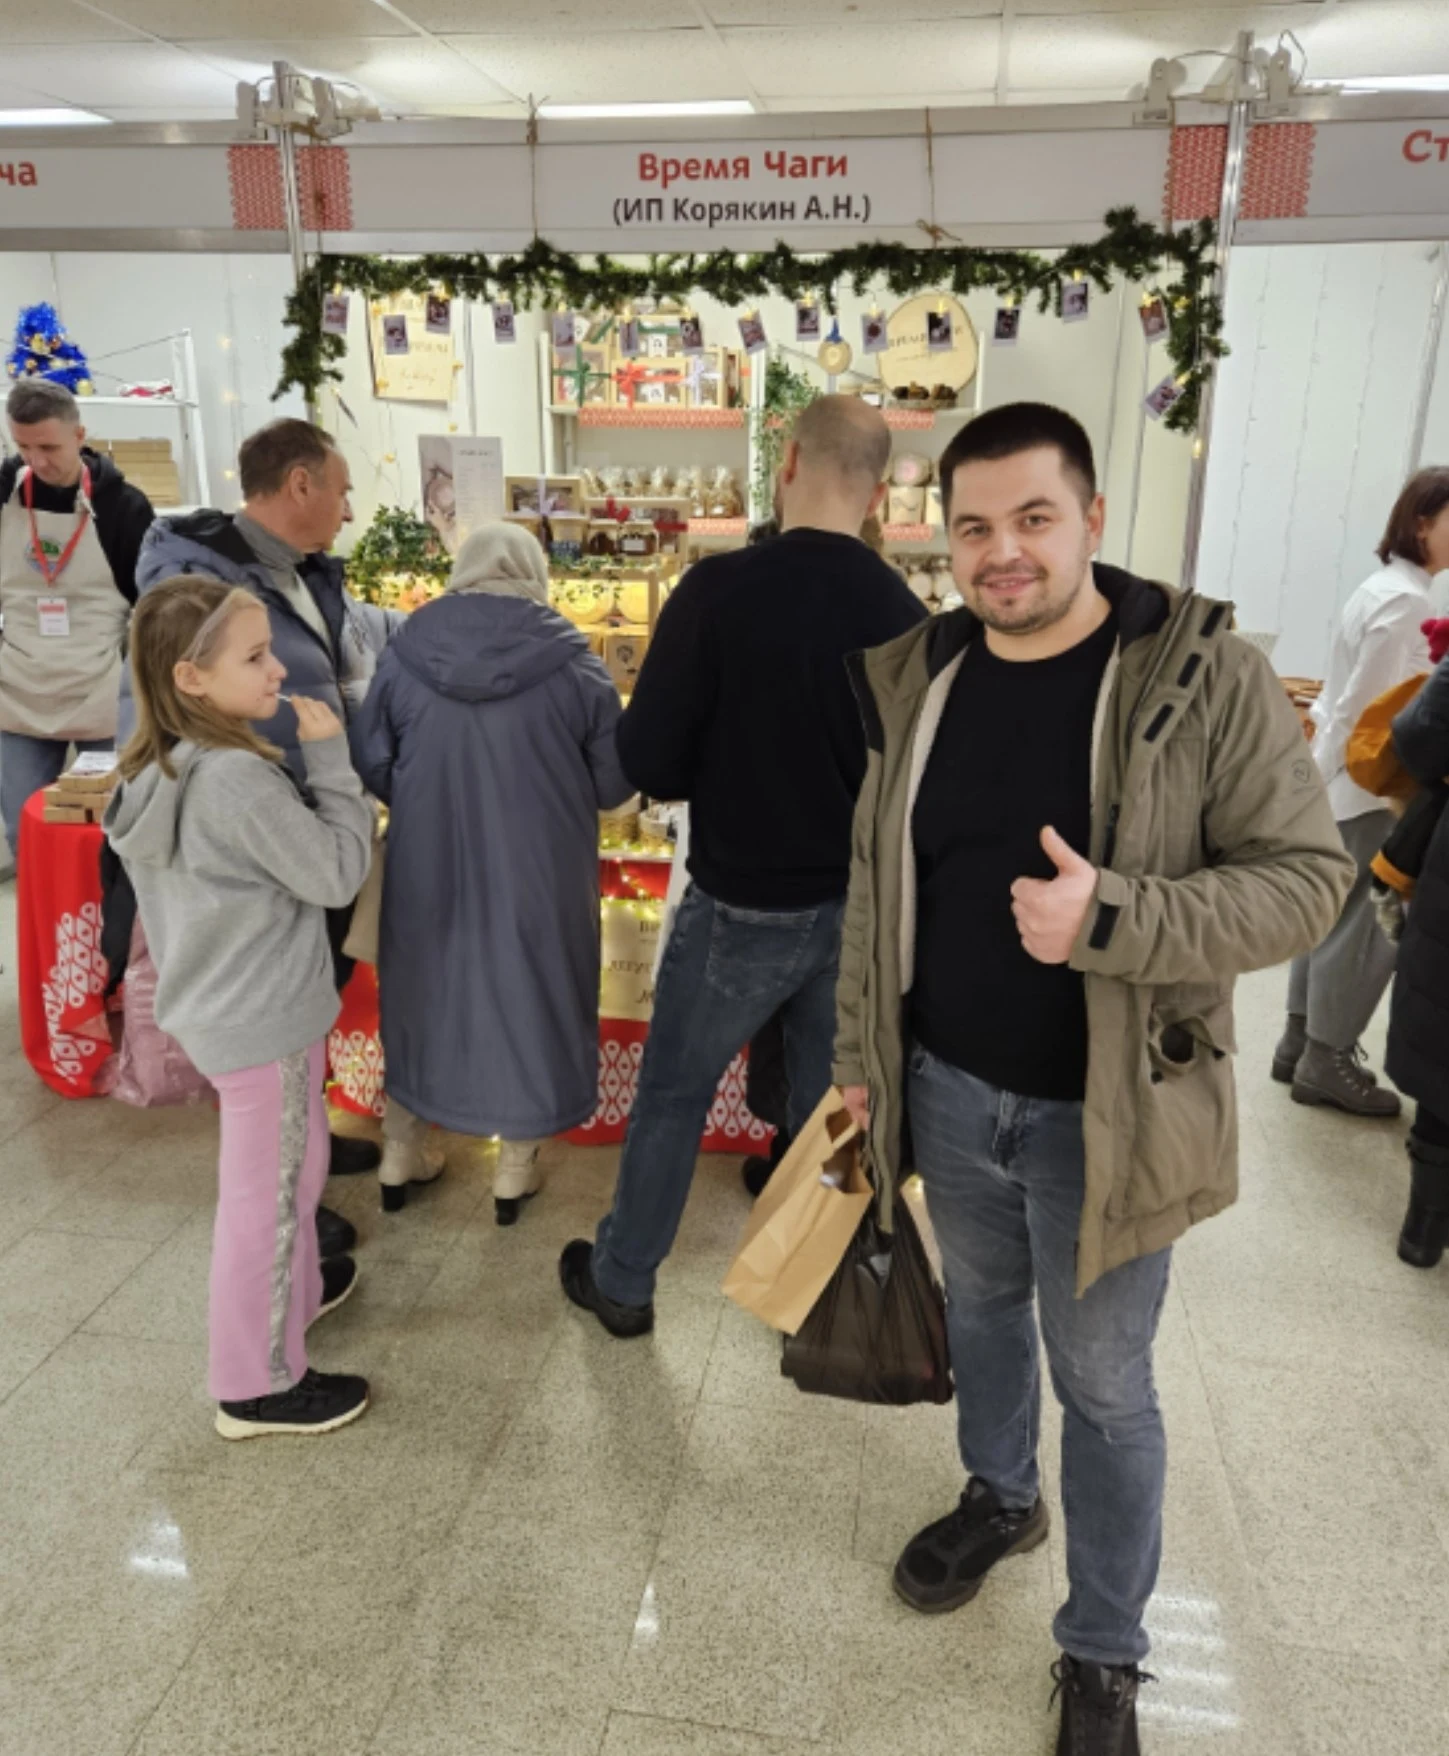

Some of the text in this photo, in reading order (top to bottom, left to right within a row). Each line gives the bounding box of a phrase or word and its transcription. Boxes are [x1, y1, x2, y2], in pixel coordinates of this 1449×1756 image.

[1402, 129, 1449, 164] Ст
[638, 151, 848, 189] Время Чаги
[613, 194, 871, 229] (ИП Корякин А.Н.)
